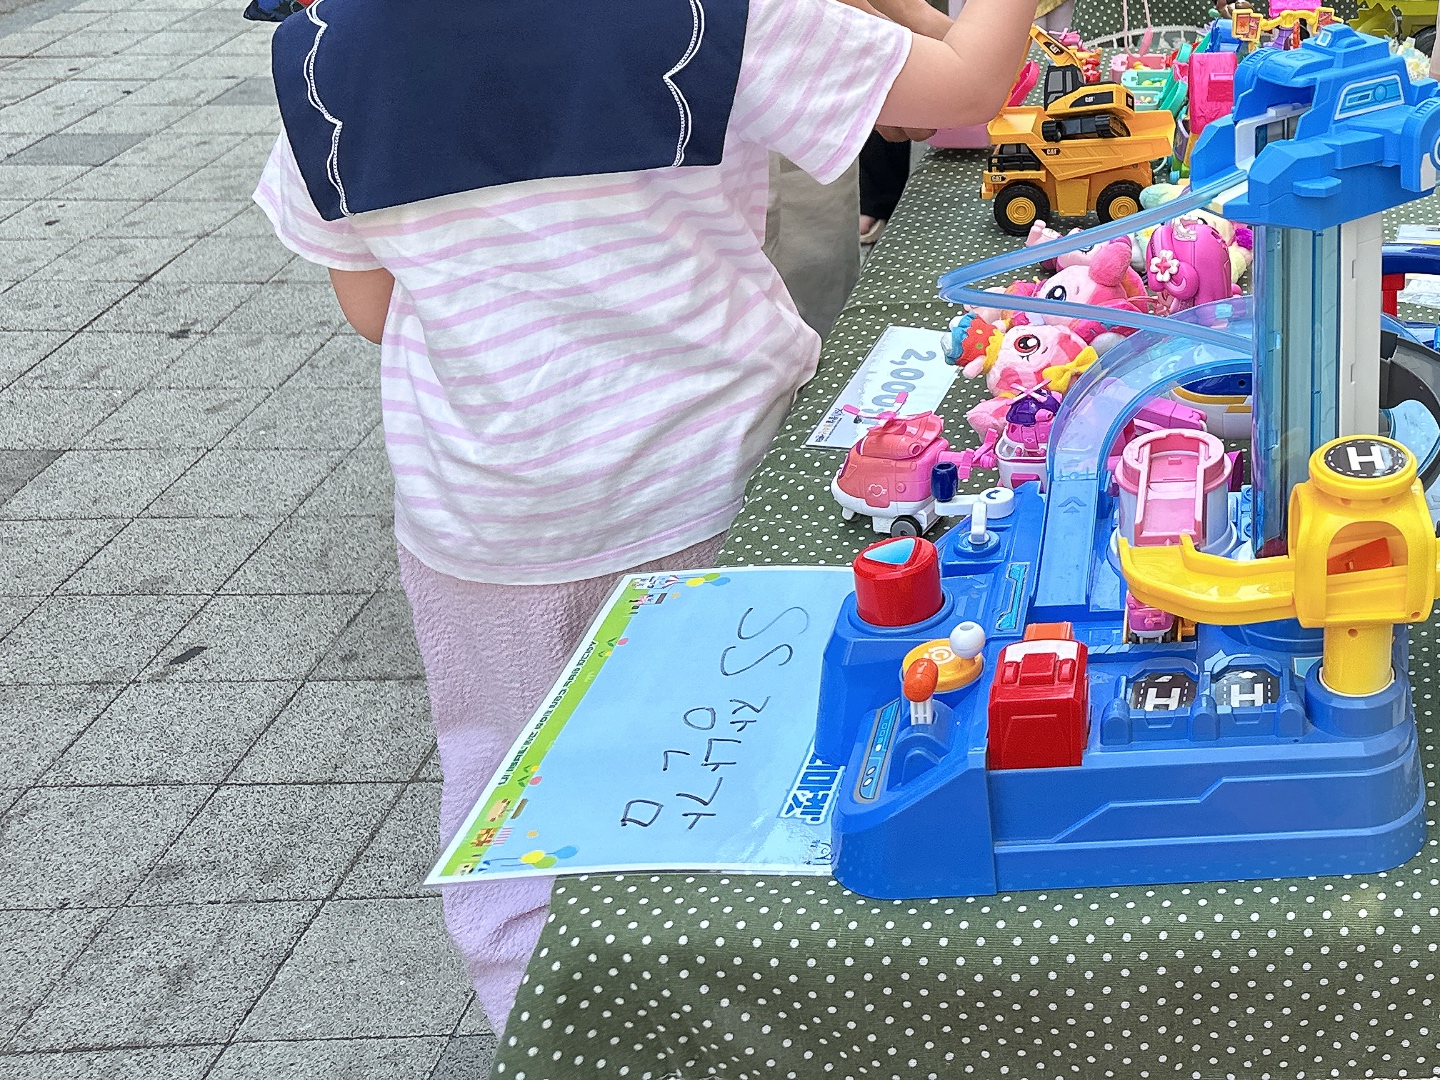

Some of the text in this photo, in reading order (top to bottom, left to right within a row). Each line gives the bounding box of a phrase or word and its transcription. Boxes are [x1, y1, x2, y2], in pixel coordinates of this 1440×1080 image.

[1049, 44, 1061, 54] CAT
[1346, 445, 1385, 471] H
[1144, 687, 1182, 712] H
[1230, 683, 1264, 707] H
[620, 606, 810, 830] SS 장난감
